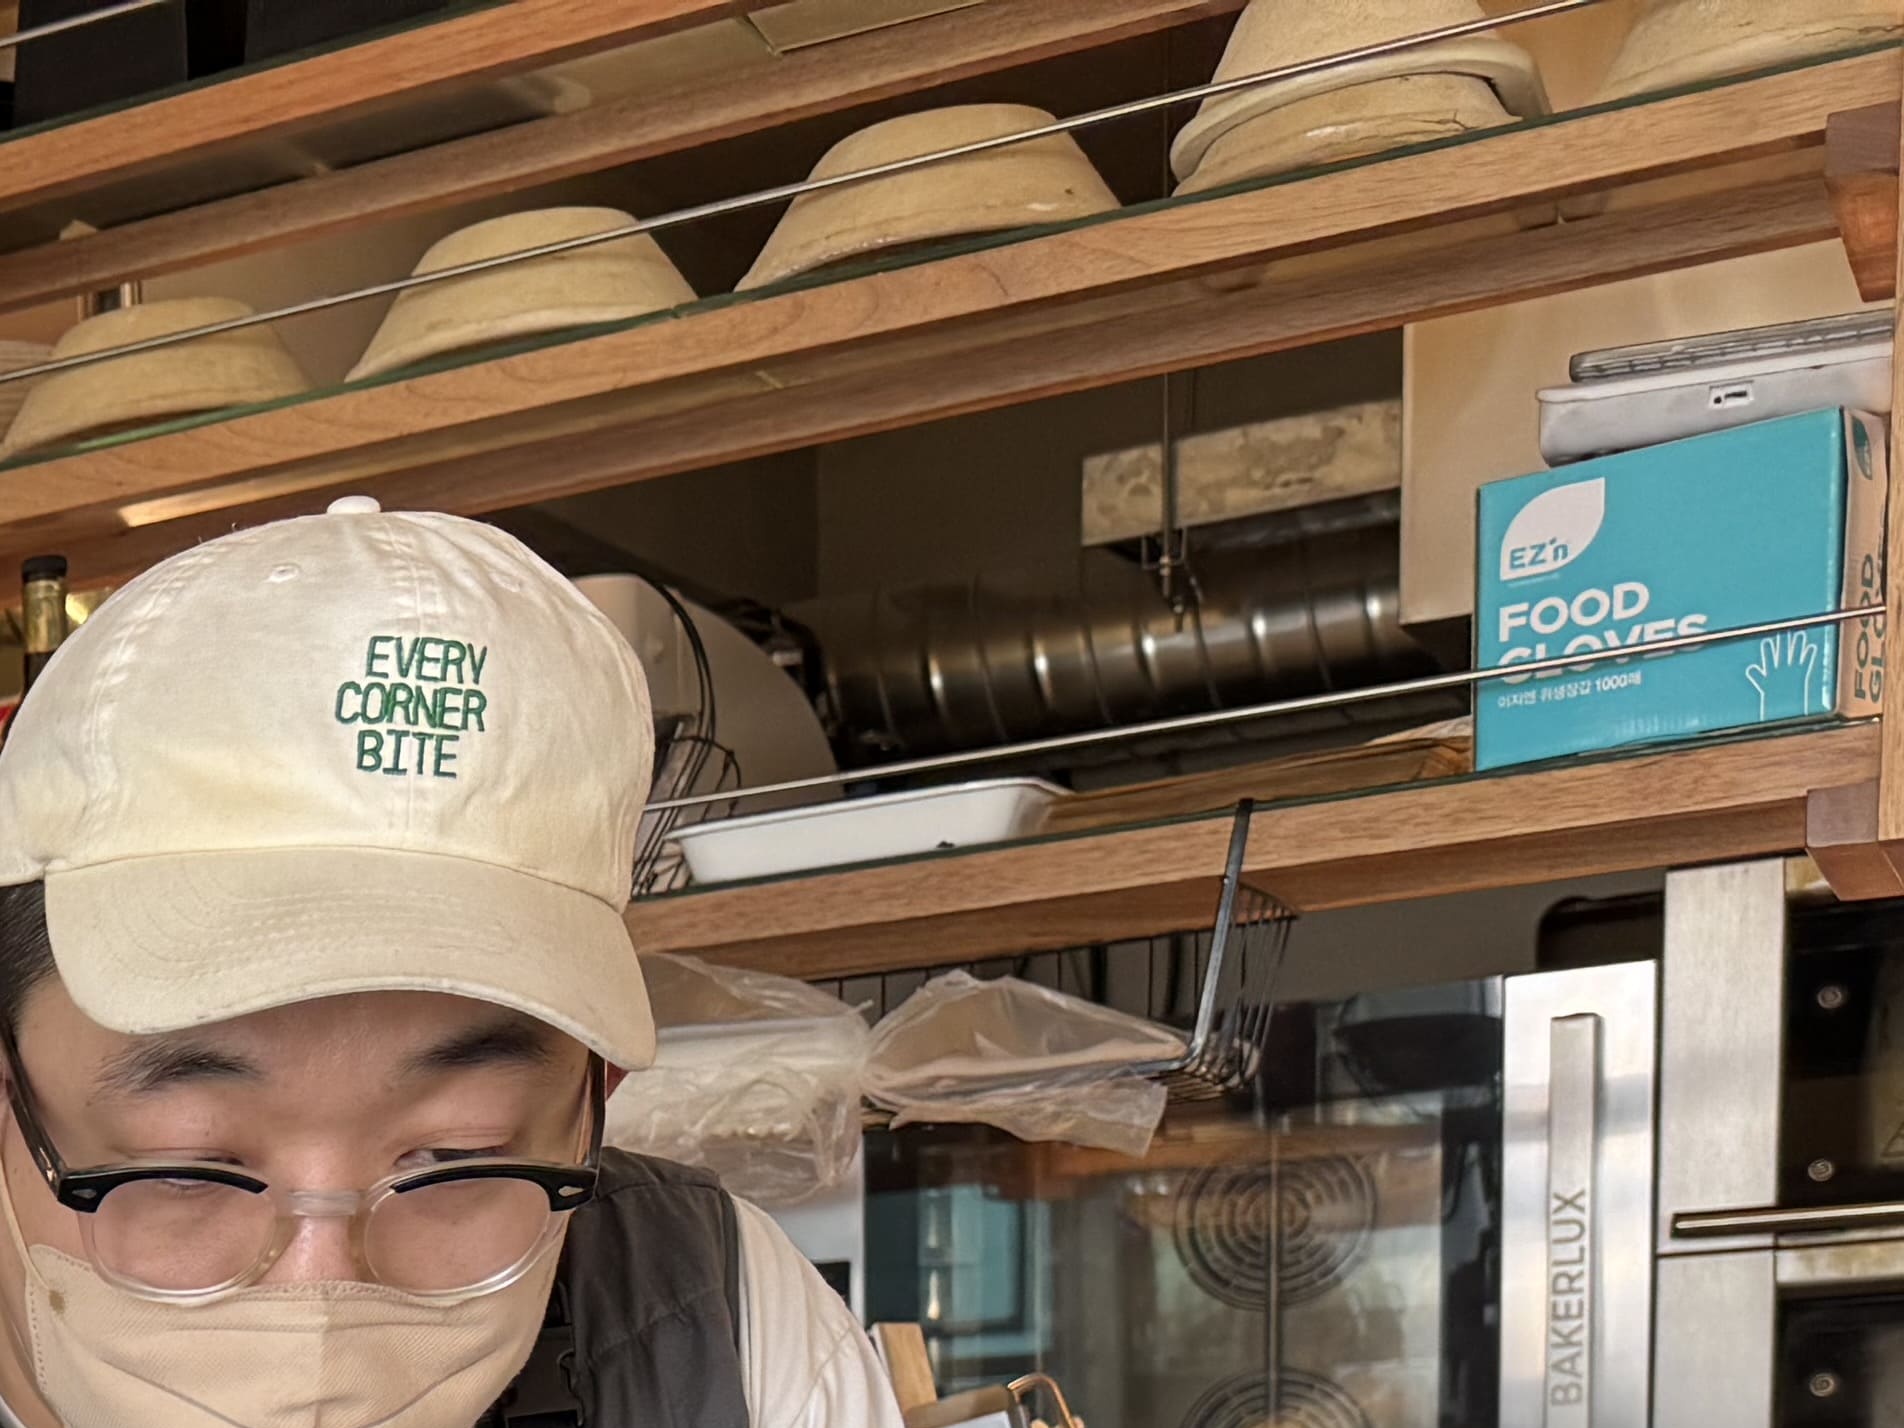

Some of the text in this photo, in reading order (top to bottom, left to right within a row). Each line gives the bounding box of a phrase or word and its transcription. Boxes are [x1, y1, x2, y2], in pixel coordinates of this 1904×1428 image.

[1498, 582, 1650, 642] FOOD
[365, 635, 488, 685] EVERY
[335, 680, 487, 732] CORNER
[356, 729, 460, 779] BITE
[1550, 1187, 1587, 1407] BAKERLUX
